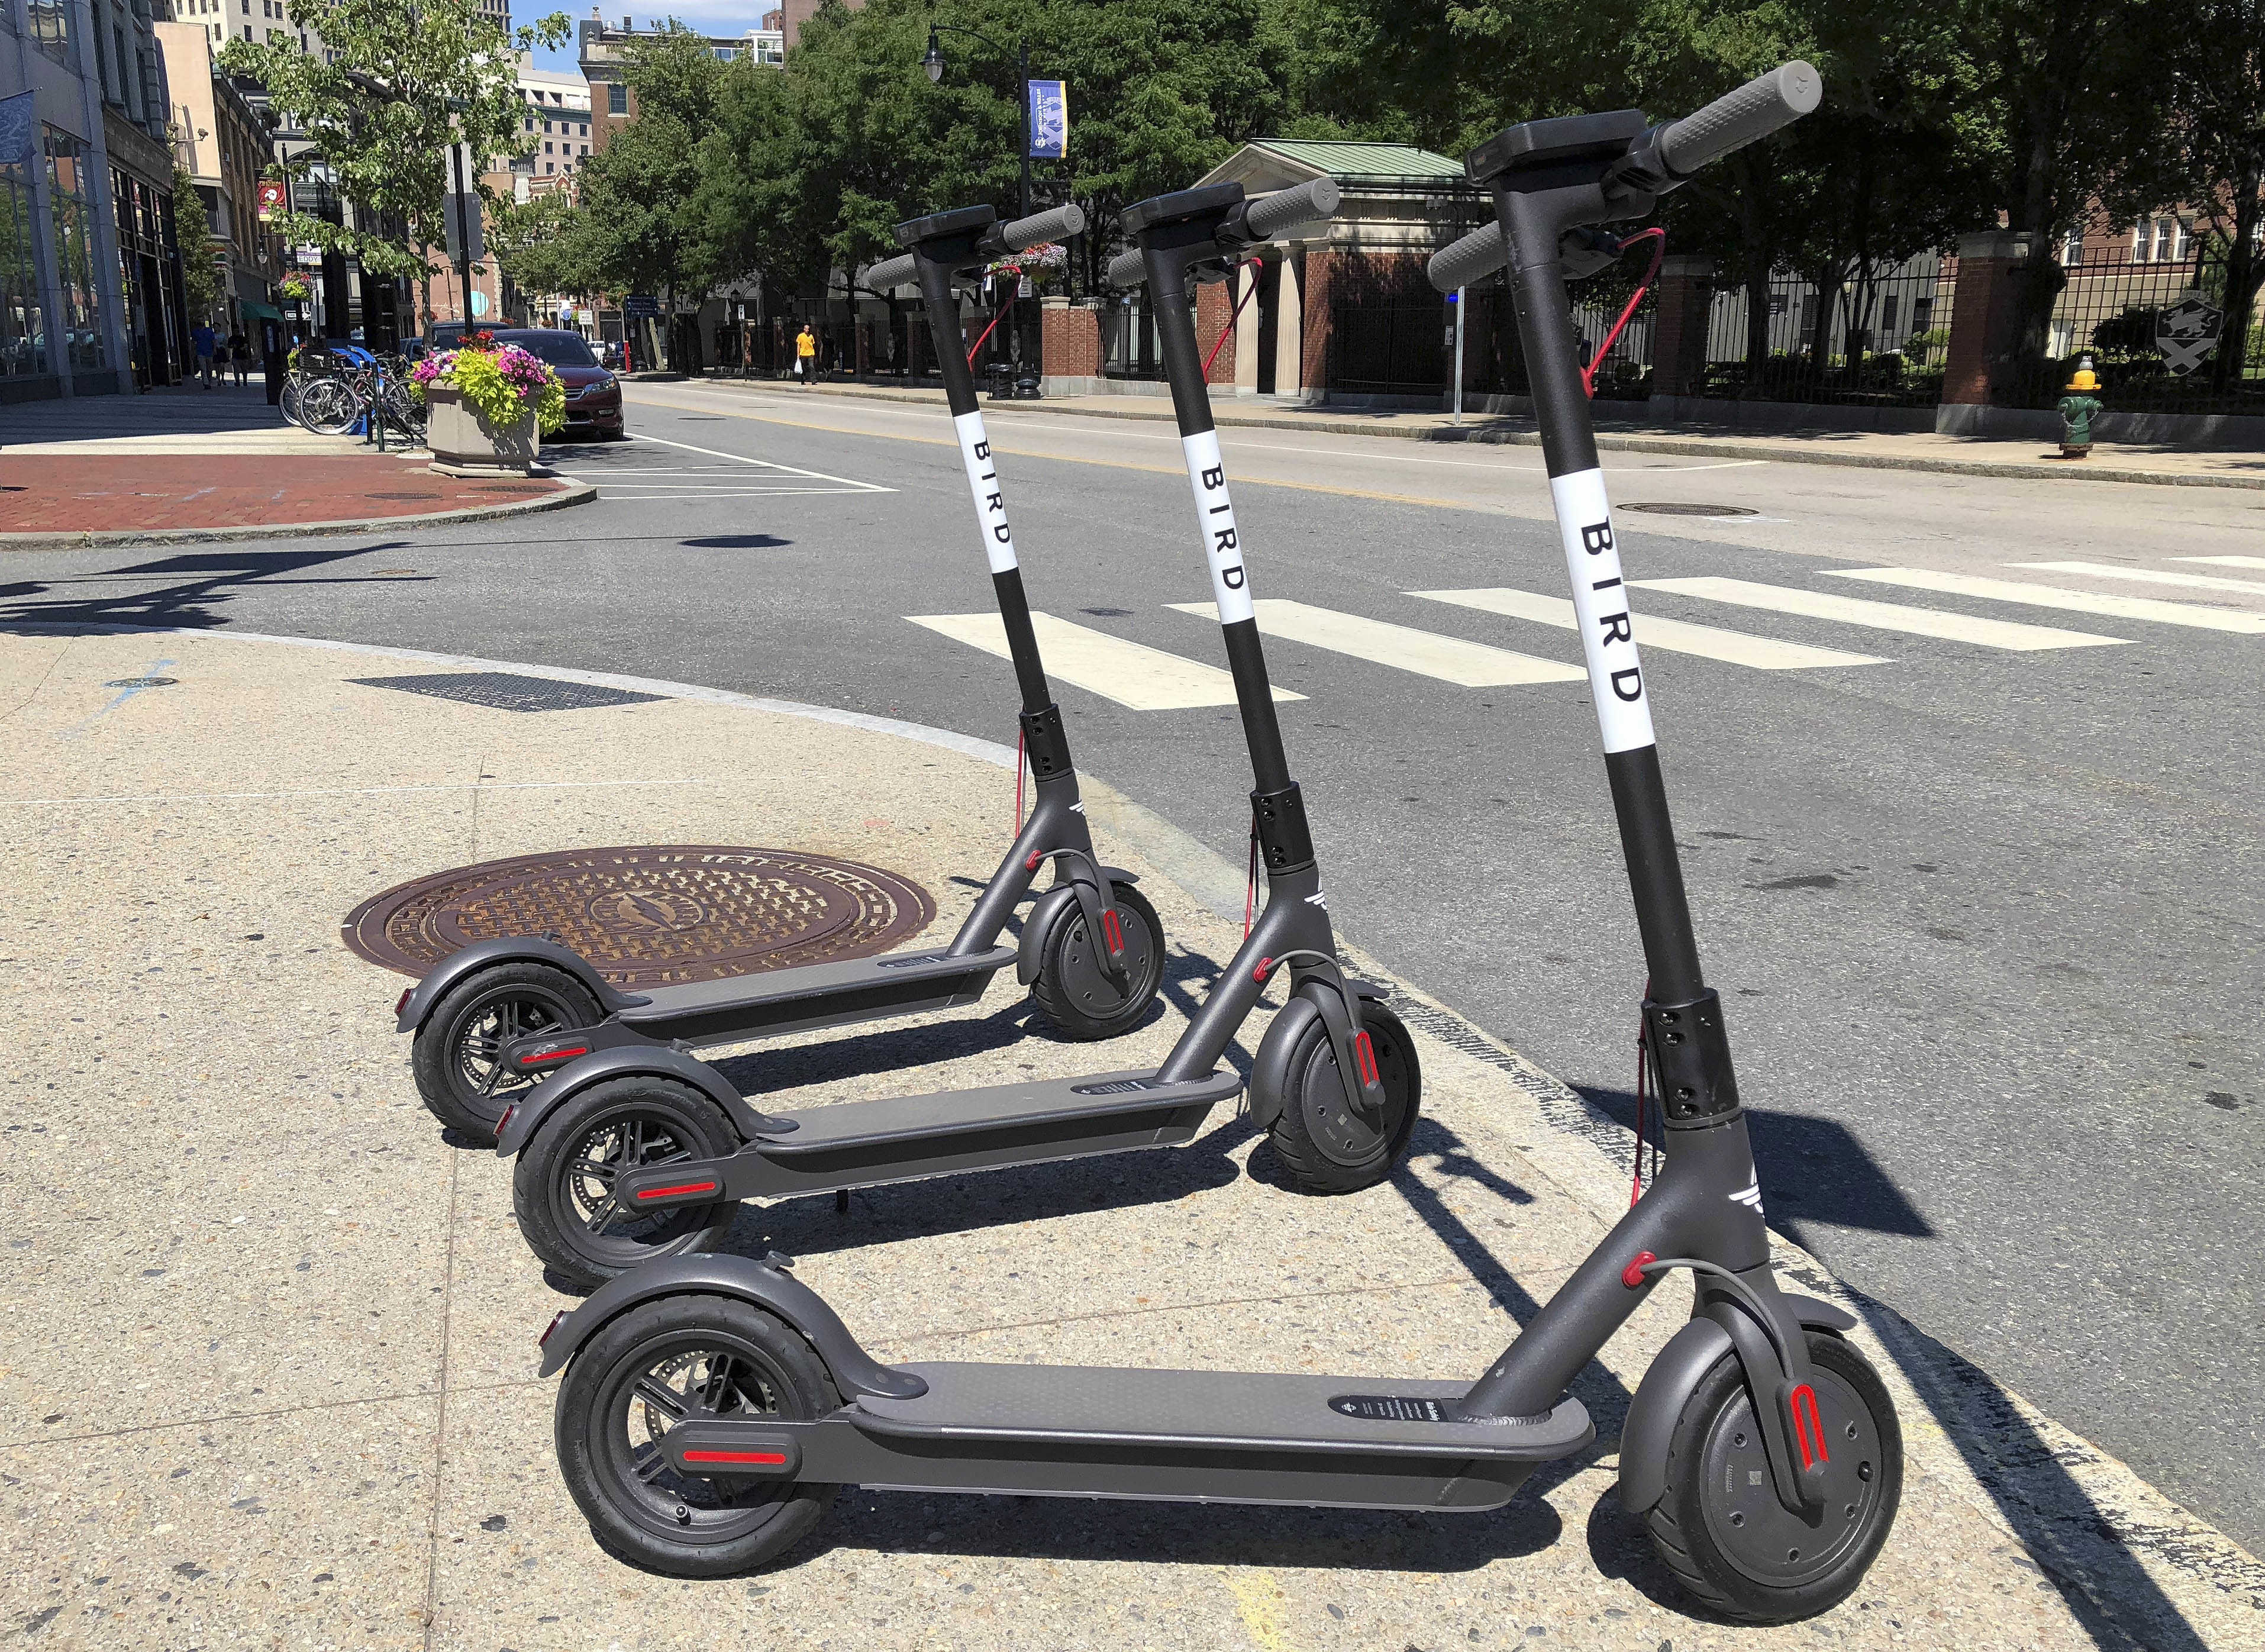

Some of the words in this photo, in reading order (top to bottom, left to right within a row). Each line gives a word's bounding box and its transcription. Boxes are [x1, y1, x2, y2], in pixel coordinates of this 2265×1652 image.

[974, 437, 1011, 543] BIRD
[1202, 462, 1244, 590] BIRD
[1581, 516, 1642, 702] BIRD
